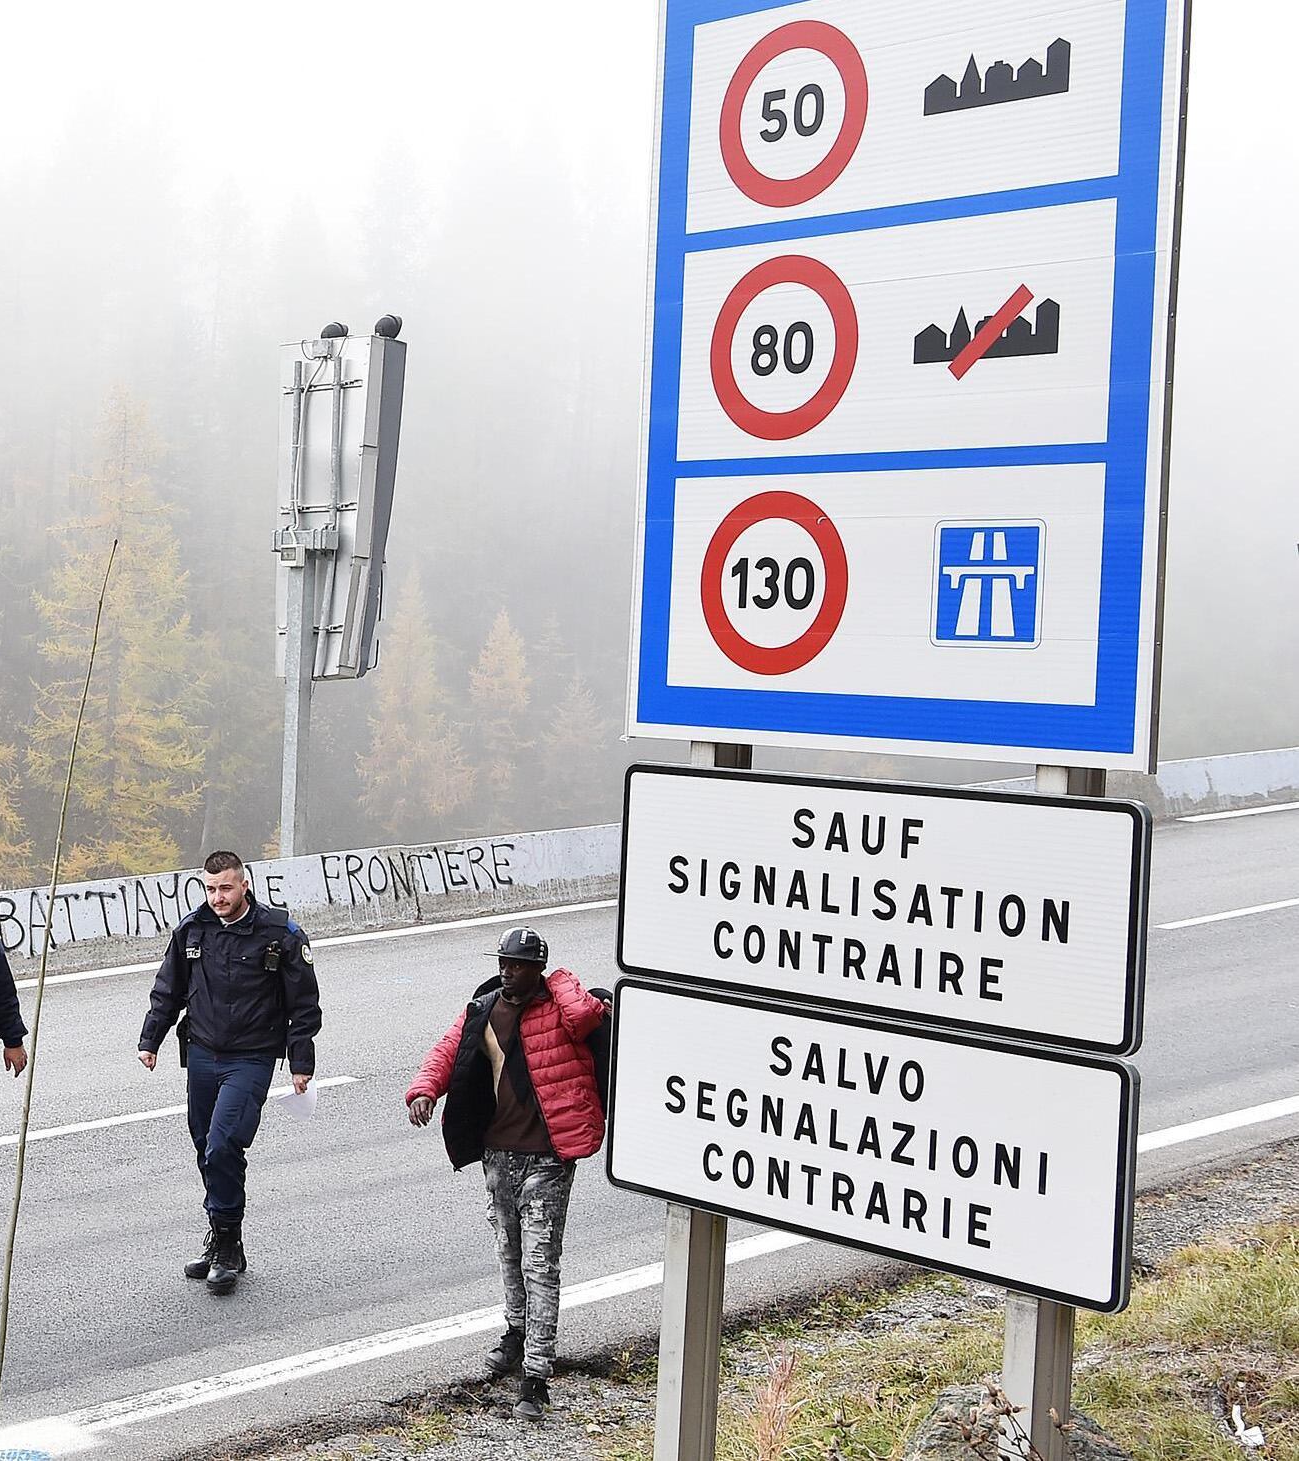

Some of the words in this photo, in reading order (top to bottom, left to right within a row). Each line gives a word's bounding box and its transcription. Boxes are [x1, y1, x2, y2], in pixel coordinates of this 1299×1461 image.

[759, 83, 825, 143] 50
[750, 321, 814, 377] 80
[731, 556, 815, 611] 130
[791, 808, 924, 859] SAUF
[321, 844, 515, 914] FRONTIERE
[667, 855, 1070, 944] SIGNALISATION
[713, 920, 1004, 1002] CONTRAIRE
[769, 1036, 925, 1103] SALVO
[664, 1075, 1048, 1196] SEGNALAZIONI
[702, 1142, 992, 1249] CONTRARIE
